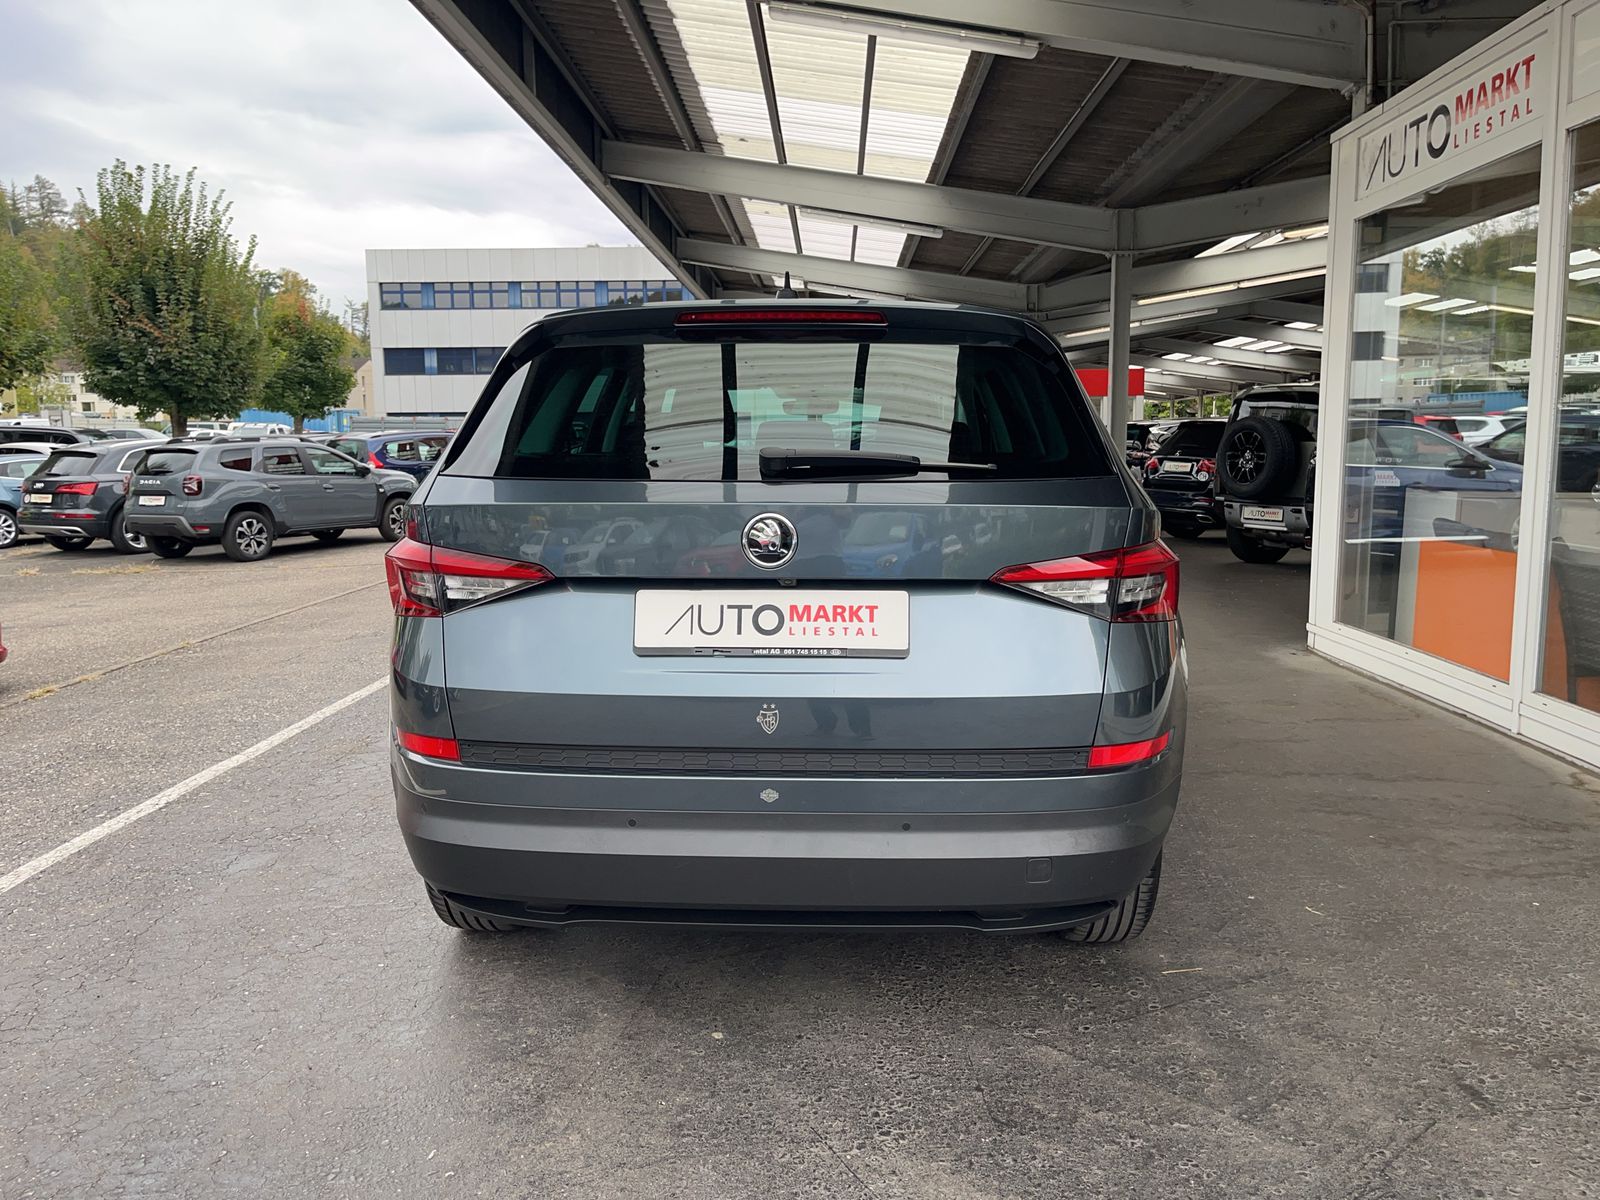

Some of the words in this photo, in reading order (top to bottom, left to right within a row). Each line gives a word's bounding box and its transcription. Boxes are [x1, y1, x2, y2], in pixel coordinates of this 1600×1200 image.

[1366, 104, 1451, 190] AUTO
[1455, 54, 1536, 125] MARKT
[1454, 98, 1533, 149] LIESTAL
[664, 603, 785, 636] AUTO
[789, 604, 879, 623] MARKT
[789, 626, 879, 637] LIESTAL
